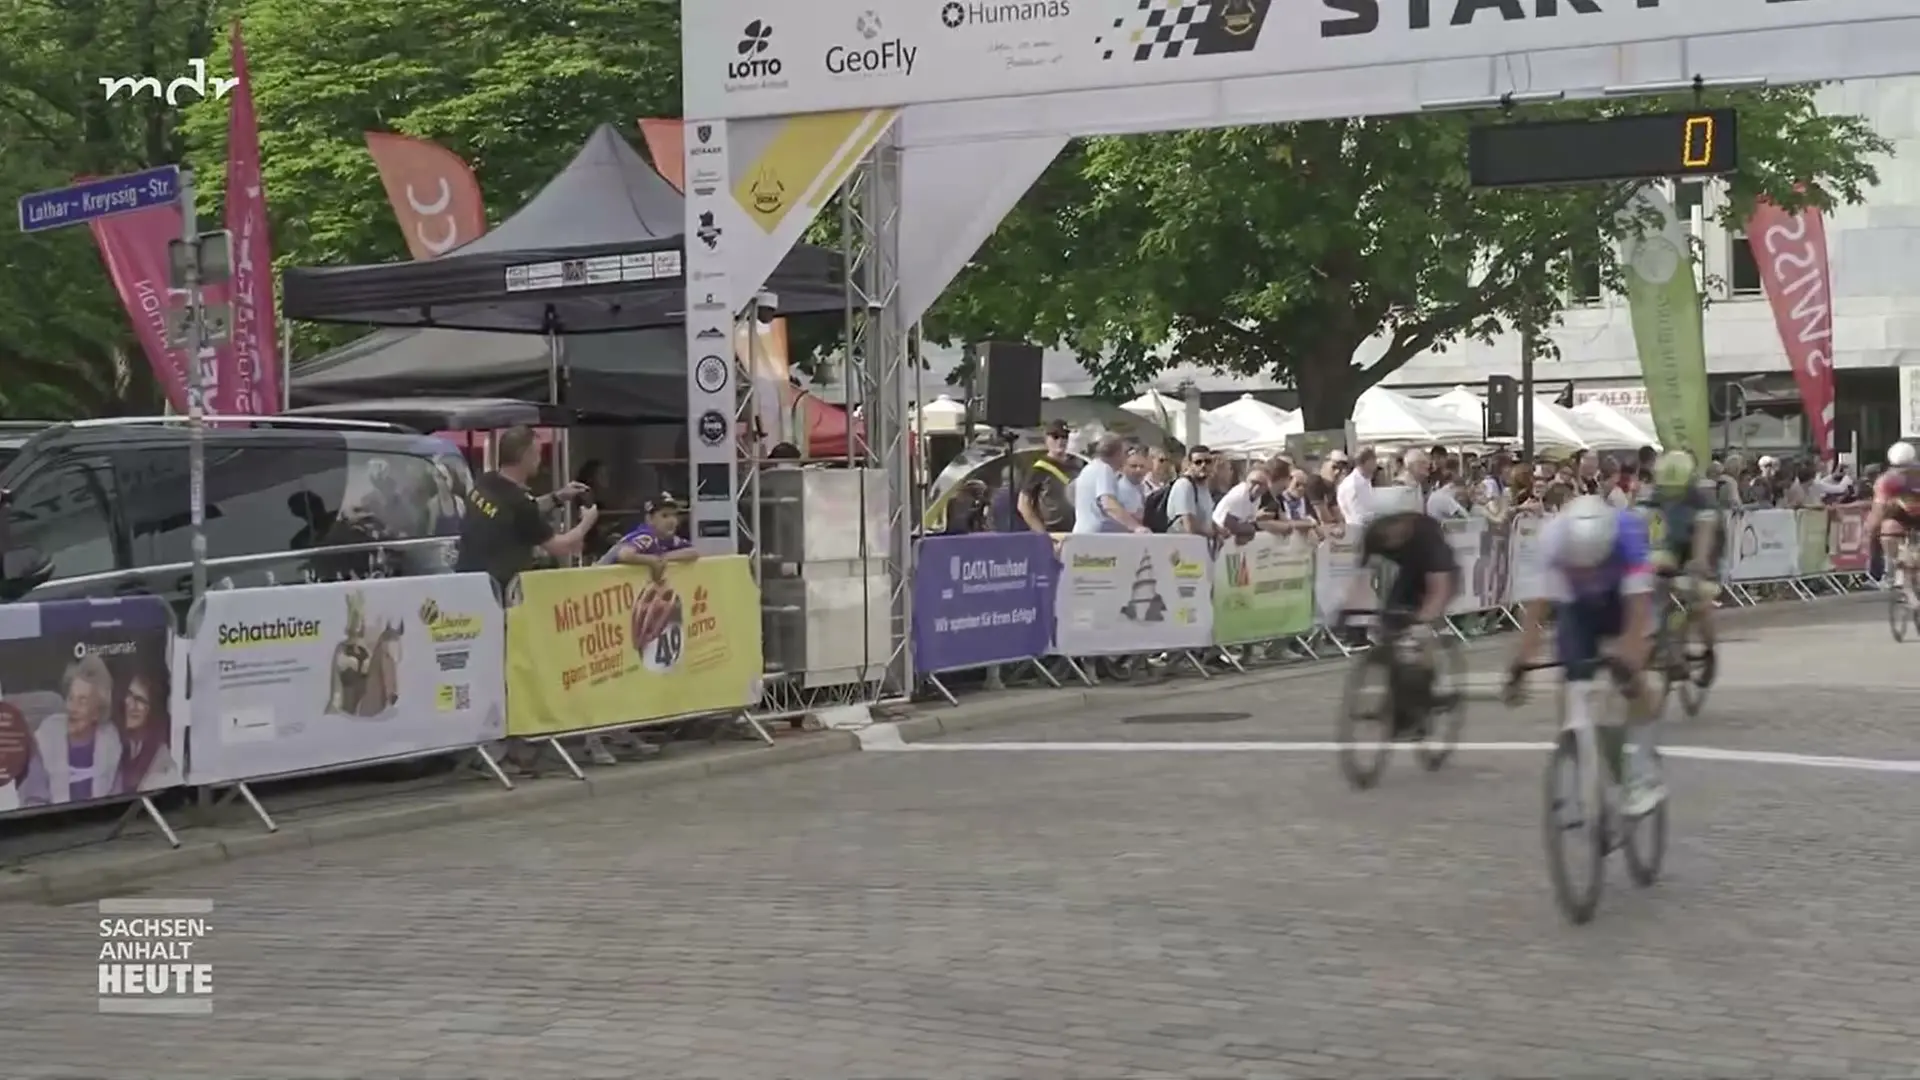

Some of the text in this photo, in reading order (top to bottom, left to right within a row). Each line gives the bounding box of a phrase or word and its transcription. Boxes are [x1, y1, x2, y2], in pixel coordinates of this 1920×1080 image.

[969, 0, 1070, 24] Humanas
[729, 58, 782, 79] LOTTO
[826, 39, 917, 76] GeoFly
[1683, 117, 1713, 166] 0
[554, 582, 634, 633] Mit LOTTO
[218, 617, 321, 645] Schatzhüter
[579, 621, 624, 657] rollts
[688, 617, 716, 638] LOTTO
[655, 624, 681, 668] 49
